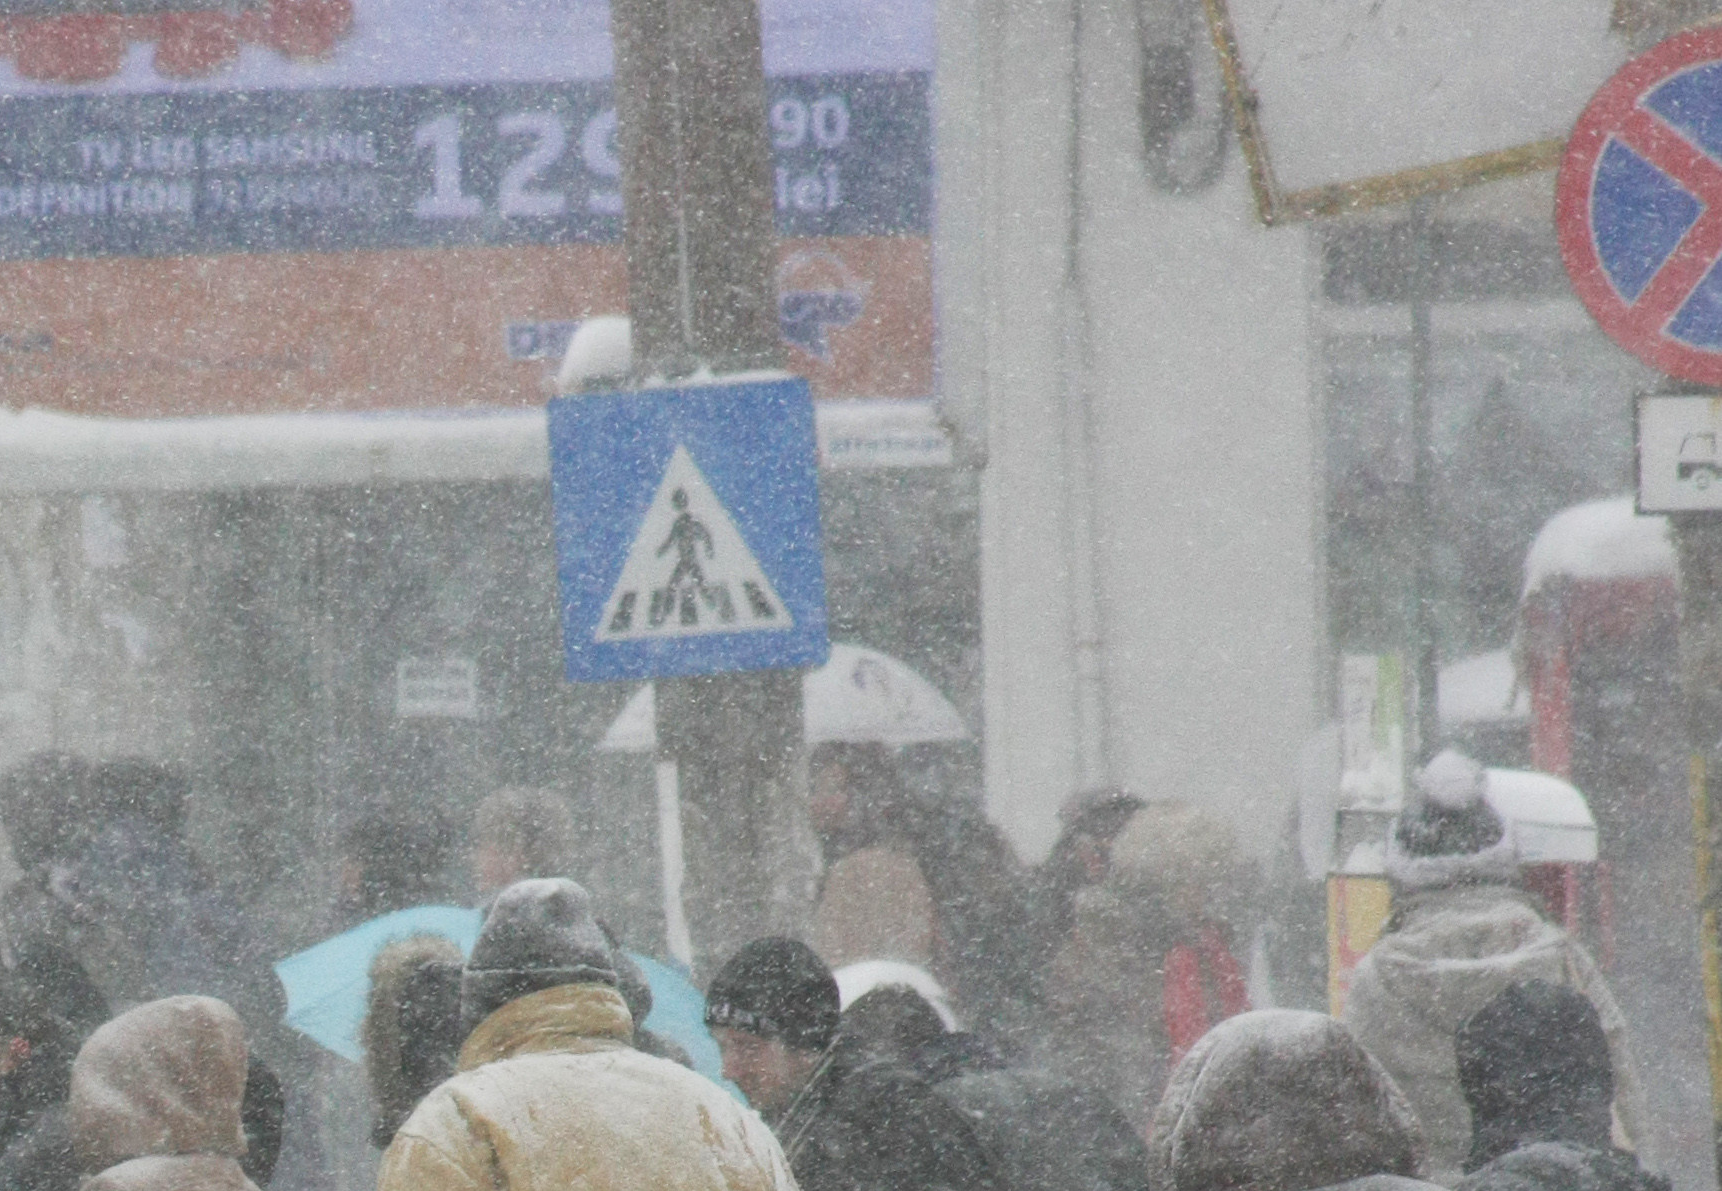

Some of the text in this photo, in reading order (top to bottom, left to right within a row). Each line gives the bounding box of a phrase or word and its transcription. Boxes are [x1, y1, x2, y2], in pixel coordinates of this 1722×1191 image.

[770, 97, 849, 148] 90
[78, 130, 376, 169] TV LED SAMSUNG
[775, 161, 839, 212] lei
